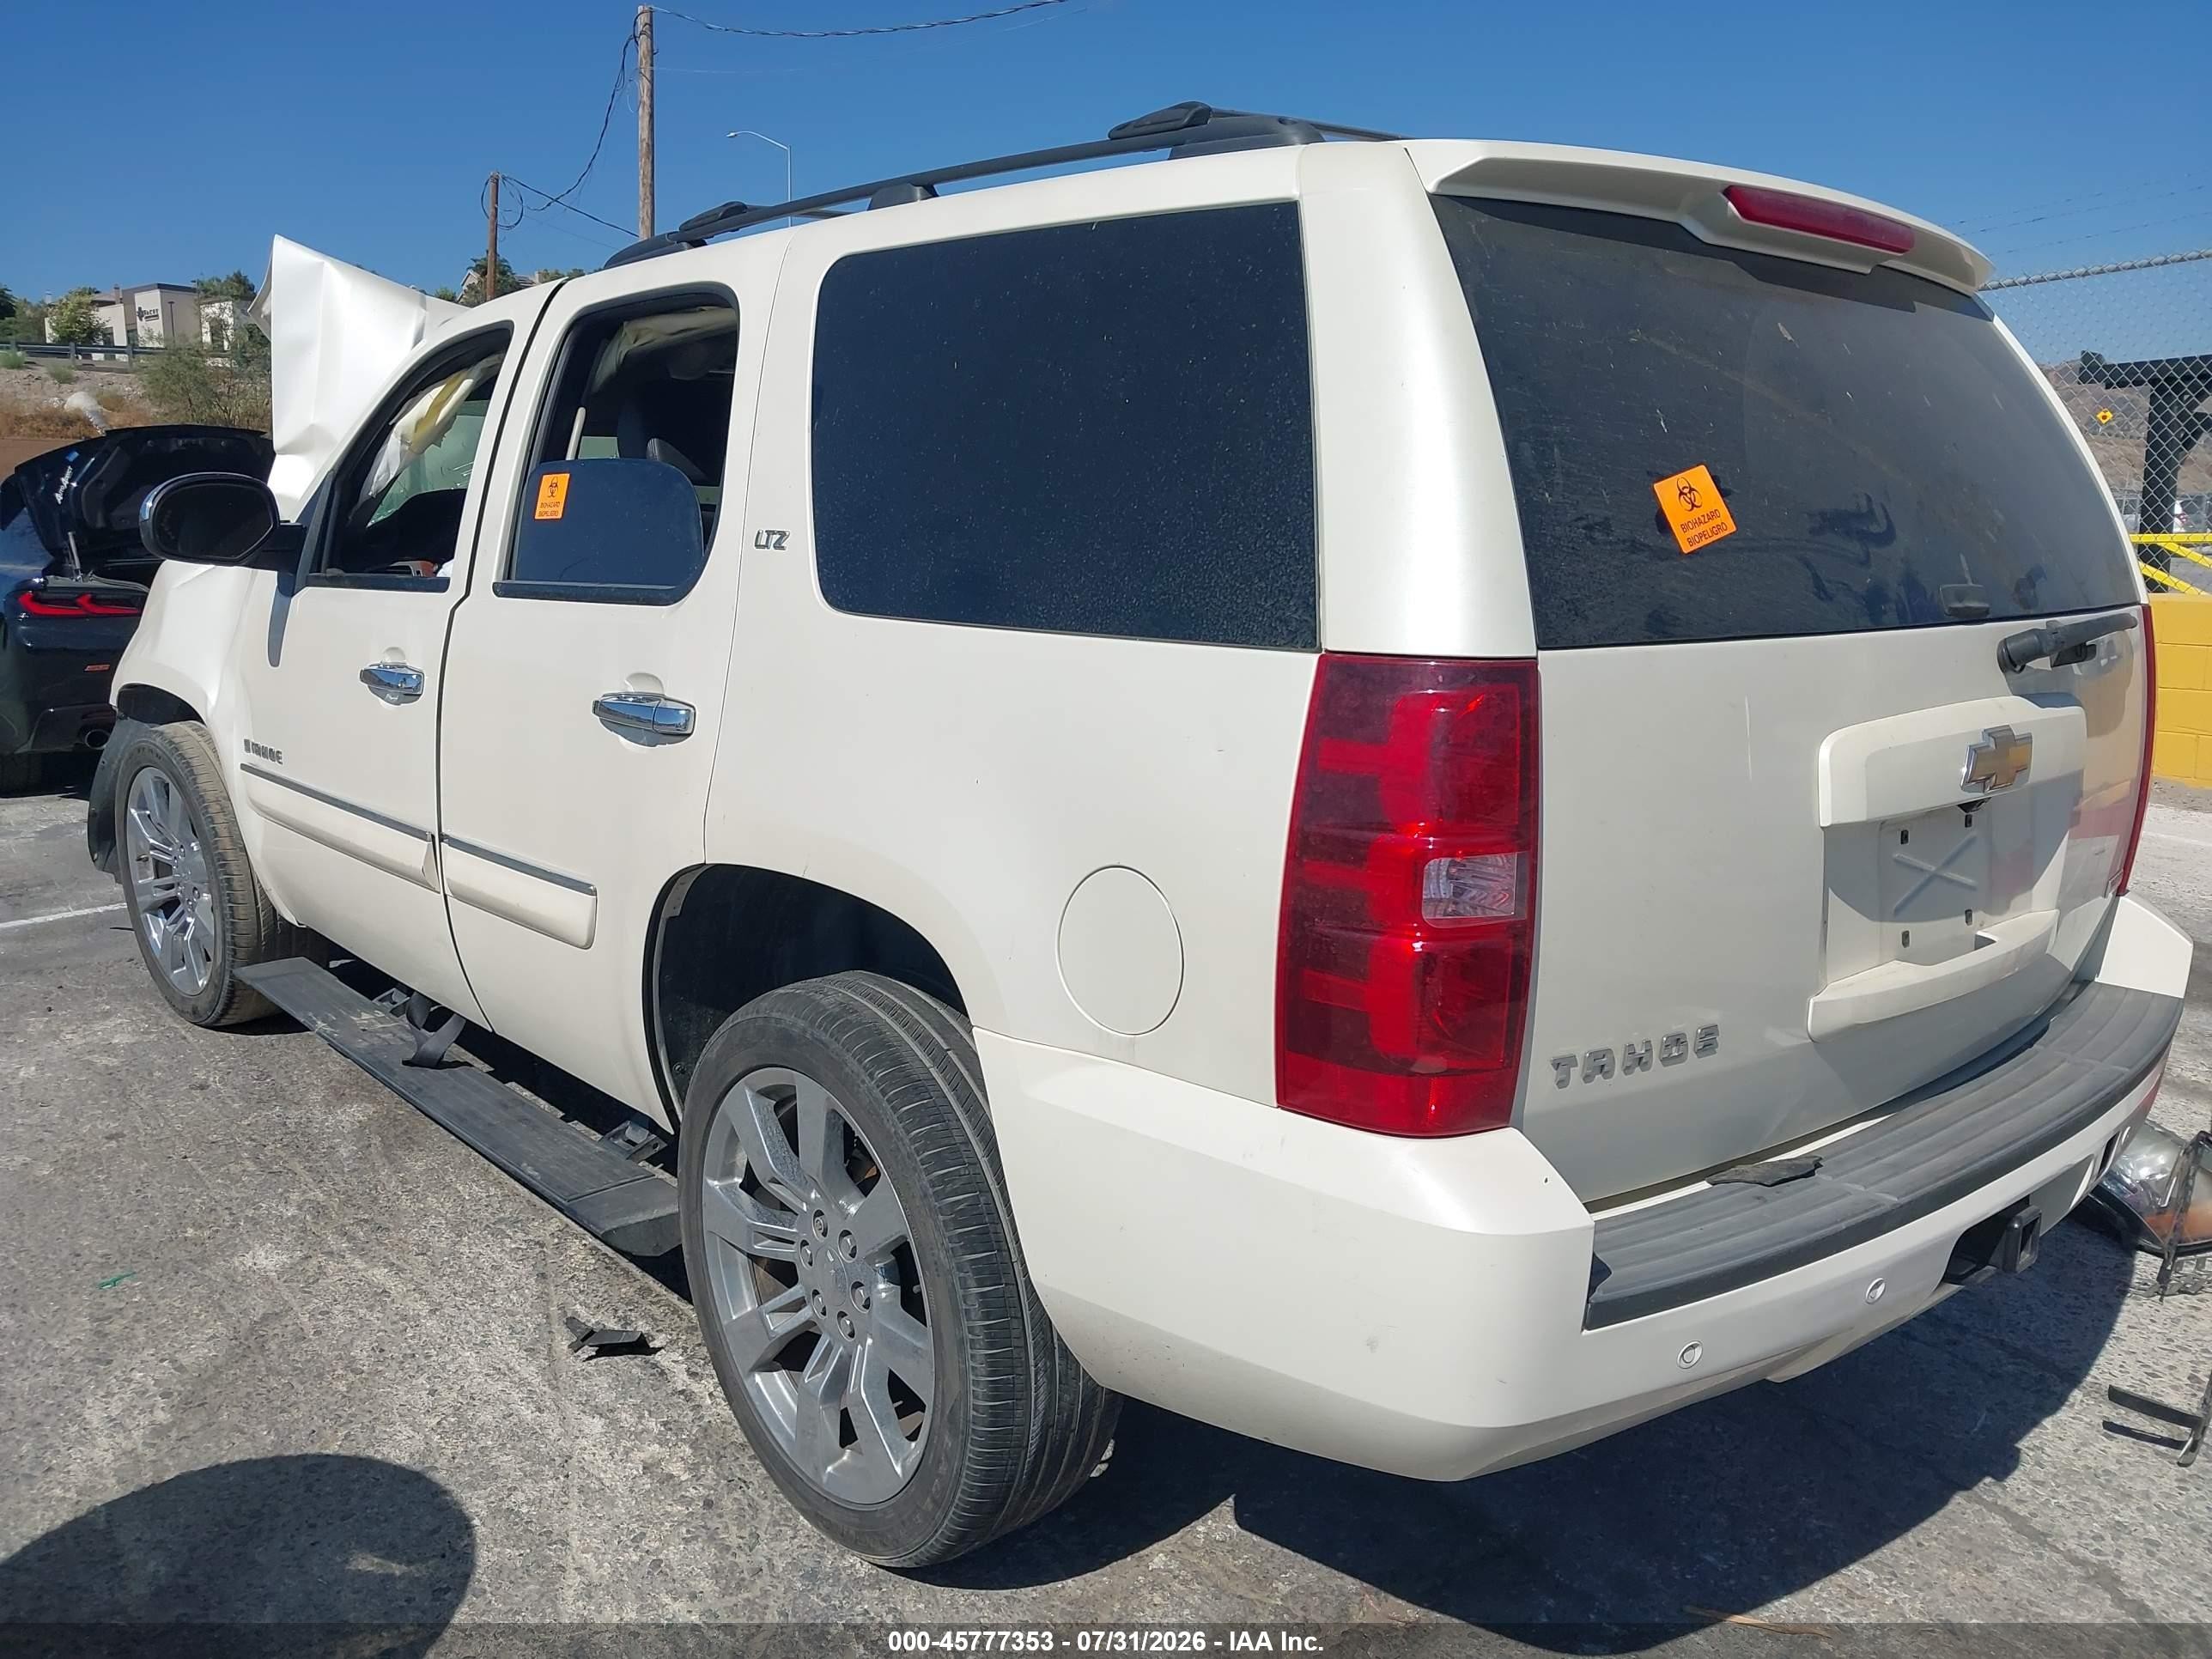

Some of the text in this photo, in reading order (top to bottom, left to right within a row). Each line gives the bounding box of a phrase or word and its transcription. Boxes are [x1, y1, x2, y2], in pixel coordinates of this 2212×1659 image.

[1680, 508, 1721, 533] BIOHAZARD
[755, 529, 790, 550] LTZ
[1686, 521, 1728, 547] BIOPELIGRO
[1551, 1024, 1719, 1090] TAHOE
